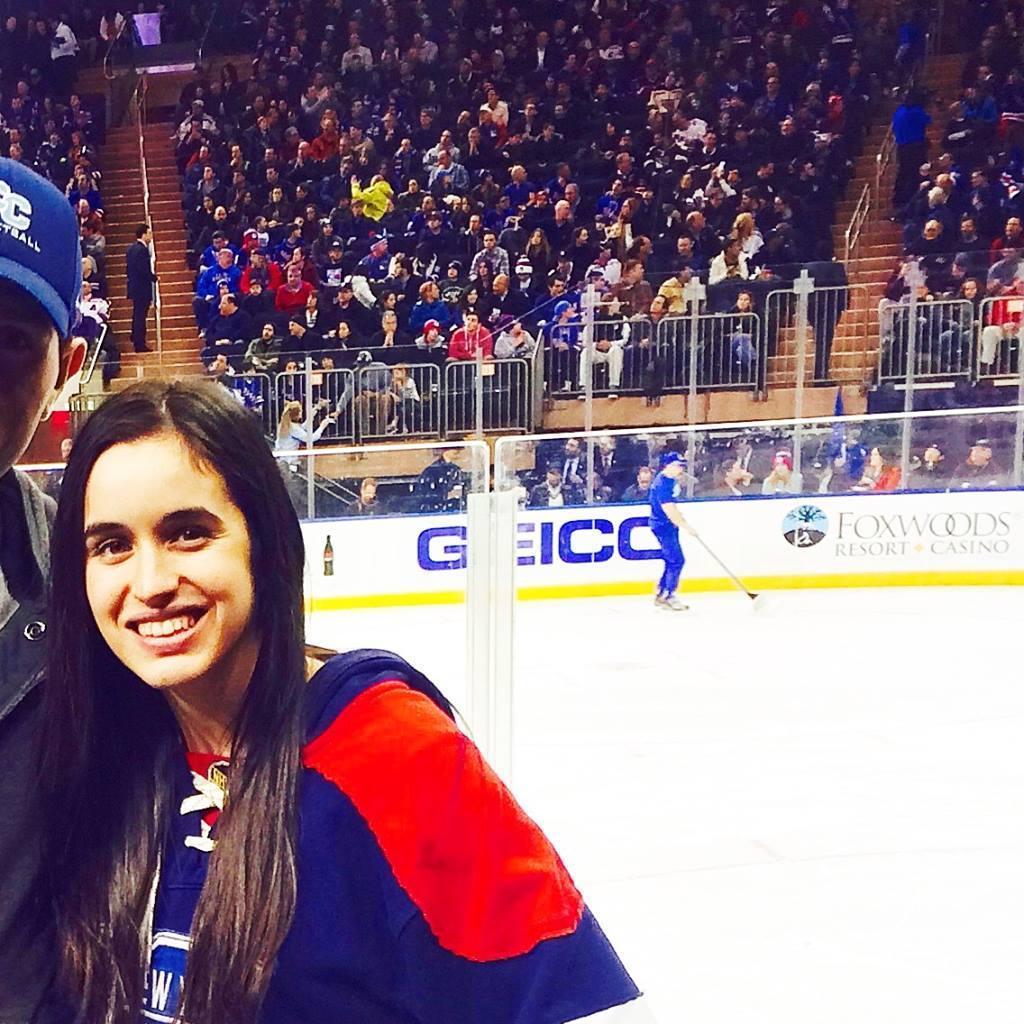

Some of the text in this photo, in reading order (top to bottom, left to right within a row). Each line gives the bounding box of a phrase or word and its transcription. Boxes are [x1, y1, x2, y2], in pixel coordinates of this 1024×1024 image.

[838, 511, 1011, 539] FOXWOODS
[835, 539, 1010, 557] RESORT CASINO
